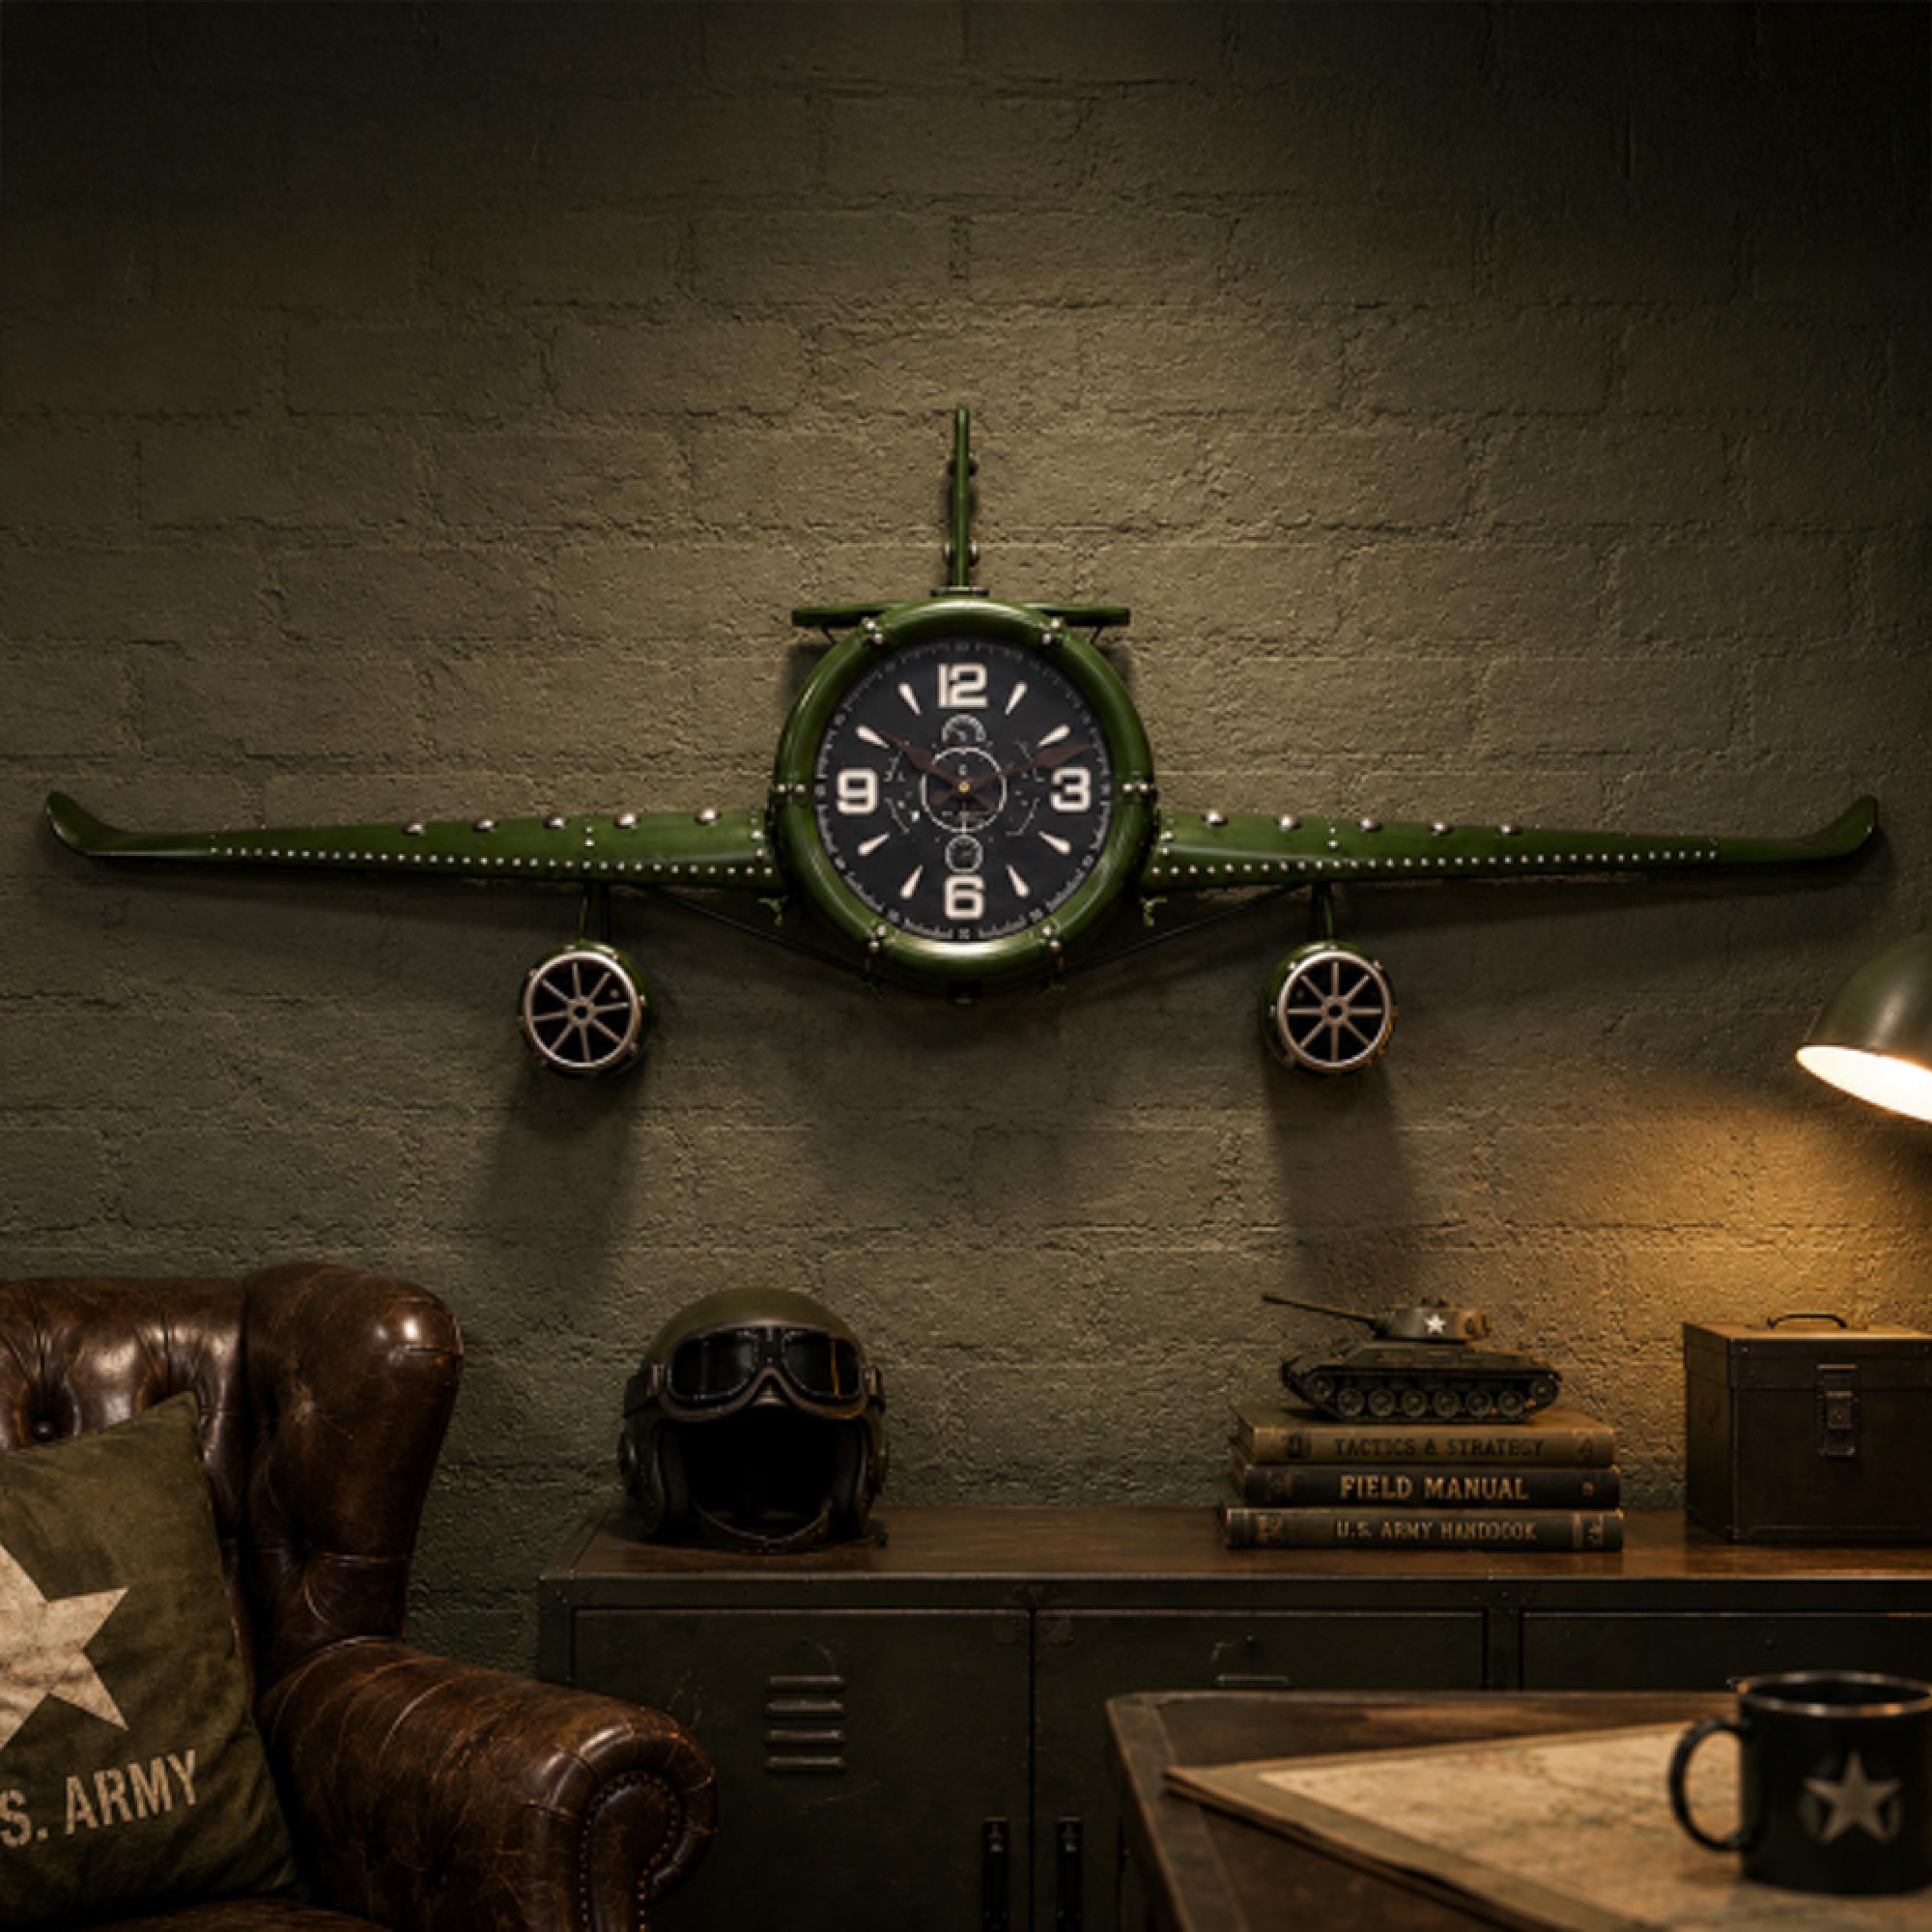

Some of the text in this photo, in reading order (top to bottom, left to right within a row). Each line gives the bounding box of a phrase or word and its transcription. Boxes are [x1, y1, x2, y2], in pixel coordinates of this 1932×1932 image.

[937, 664, 988, 708] 12
[837, 768, 878, 814] 9
[1051, 768, 1092, 811] 3
[944, 875, 984, 919] 6
[1334, 1436, 1417, 1457] TACTICS
[1340, 1475, 1531, 1500] FIELD MANUAL
[1380, 1521, 1433, 1540] ARMY
[65, 1749, 198, 1834] ARMY
